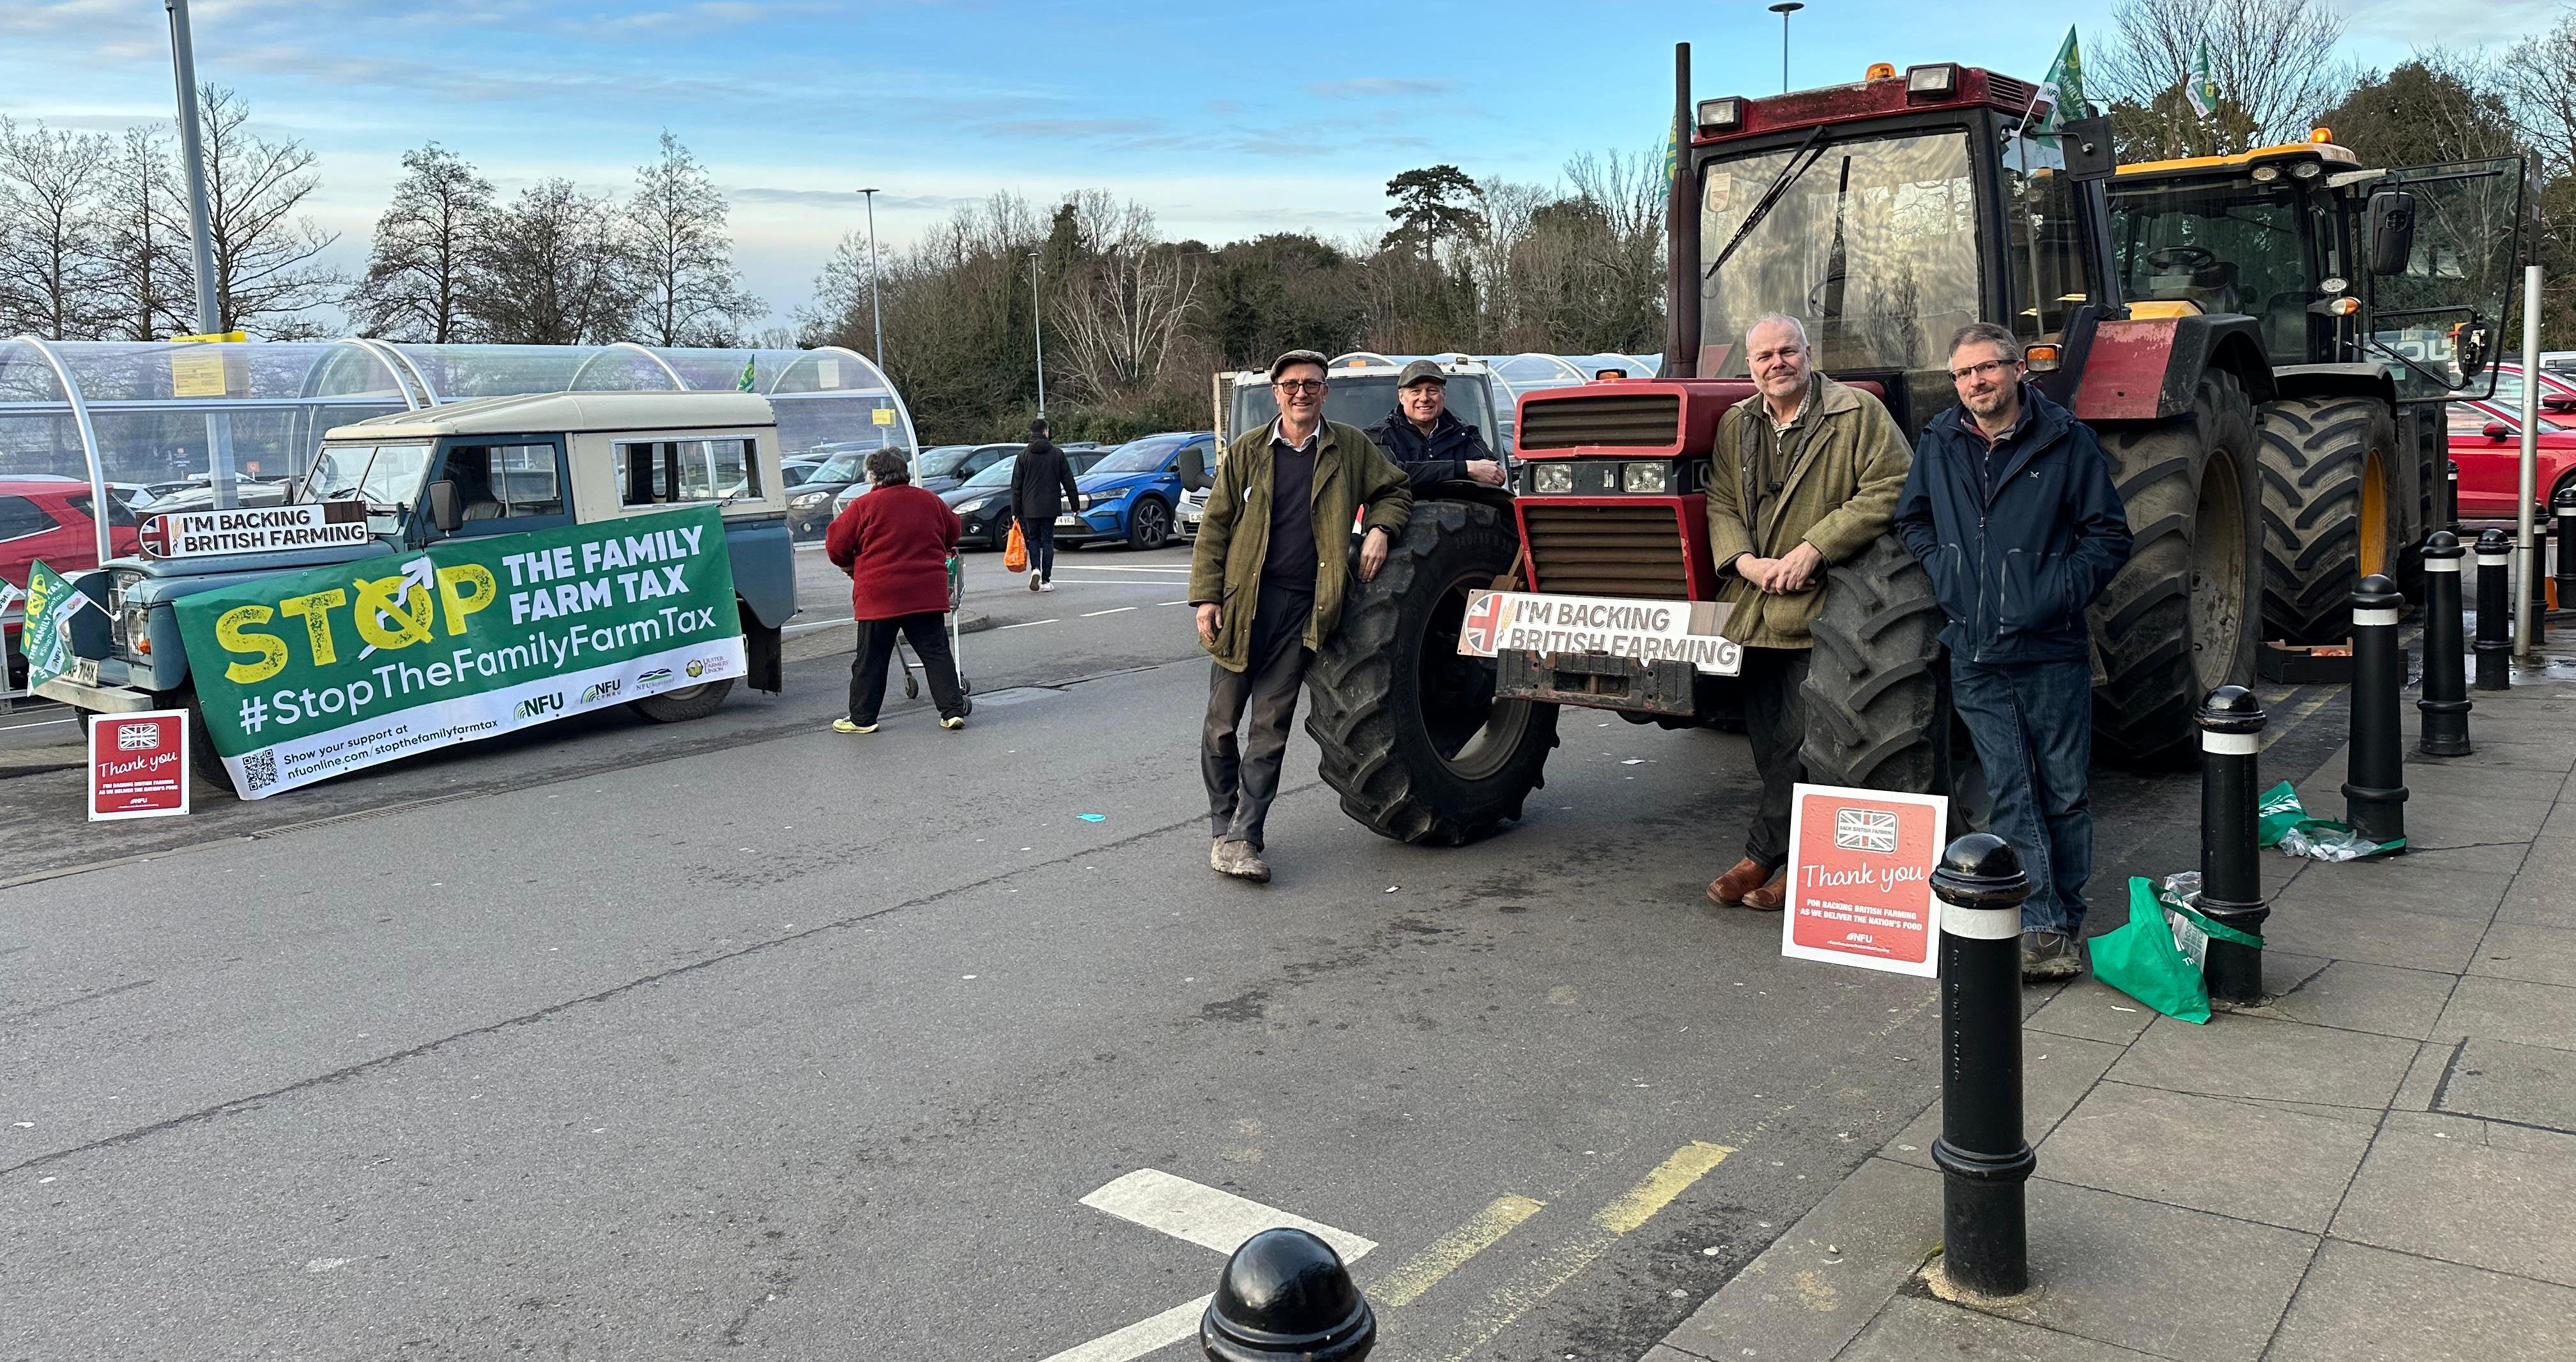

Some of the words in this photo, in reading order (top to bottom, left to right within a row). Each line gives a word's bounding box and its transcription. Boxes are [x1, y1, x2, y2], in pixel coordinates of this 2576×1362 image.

[183, 516, 214, 532] I'M
[220, 510, 310, 529] BACKING
[185, 532, 264, 552] BRITISH
[270, 525, 365, 544] FARMING
[502, 546, 575, 586] THE
[581, 525, 703, 574] FAMILY
[509, 578, 613, 625] FARM
[618, 564, 689, 603] TAX
[216, 563, 496, 684] STOP
[1515, 601, 1553, 624] I'M
[1557, 603, 1671, 632] BACKING
[54, 647, 62, 664] NFU
[1510, 627, 1606, 653] BRITISH
[1611, 634, 1737, 666] FARMING
[239, 606, 716, 735] #StopTheFamilyFarmTax
[703, 656, 724, 664] ULSTER
[595, 679, 621, 696] NFU
[597, 691, 622, 701] CYMRU
[525, 692, 564, 717] NFU
[284, 749, 315, 765] Show
[319, 742, 344, 759] your
[348, 728, 394, 748] support
[395, 724, 408, 735] at
[288, 719, 498, 779] nfuonline.com/stopthefamilyfarmtax
[98, 755, 148, 778] Thank
[150, 752, 178, 772] you
[1801, 862, 1876, 888] Thank
[1880, 866, 1925, 893] you
[1807, 899, 1820, 907] FOR
[1822, 901, 1852, 912] BACKING
[1854, 905, 1882, 915] BRITISH
[1883, 908, 1917, 920] FARMING
[1811, 909, 1822, 917] WE
[1823, 911, 1852, 922] DELIVER
[1853, 914, 1867, 924] THE
[1868, 917, 1901, 928] NATION'S
[1903, 921, 1922, 931] FOOD
[1853, 933, 1873, 944] NFU
